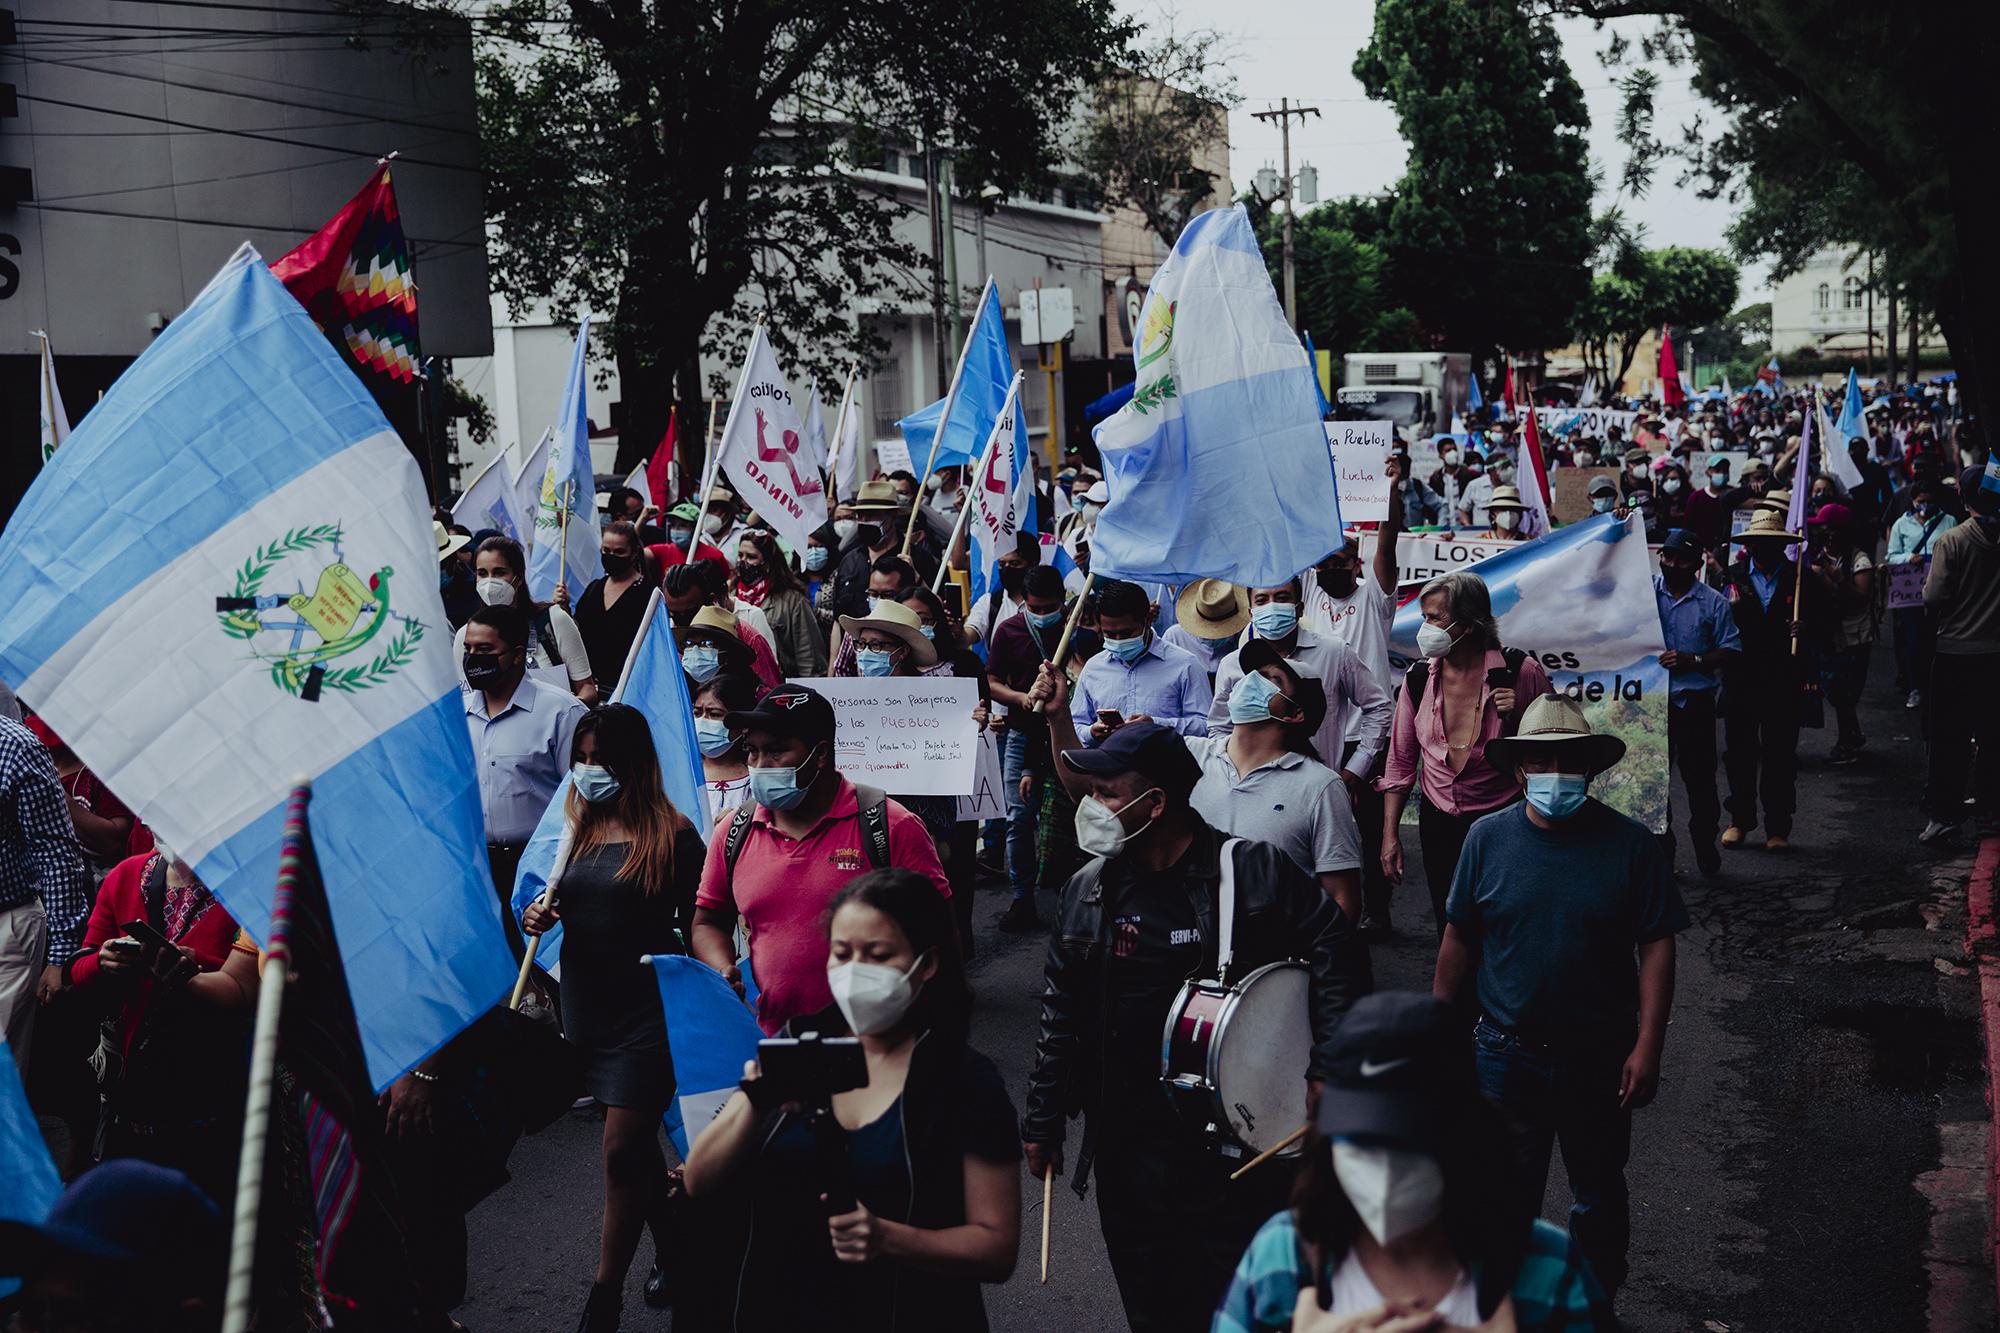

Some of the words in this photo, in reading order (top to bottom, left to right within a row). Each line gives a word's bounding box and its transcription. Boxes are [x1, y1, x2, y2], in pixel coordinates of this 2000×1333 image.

[1344, 428, 1385, 447] Pueblos
[1342, 467, 1374, 481] Lucha
[1434, 543, 1485, 563] LOS
[1565, 676, 1605, 702] de
[1614, 675, 1642, 701] la
[881, 715, 940, 728] PUEBLOS
